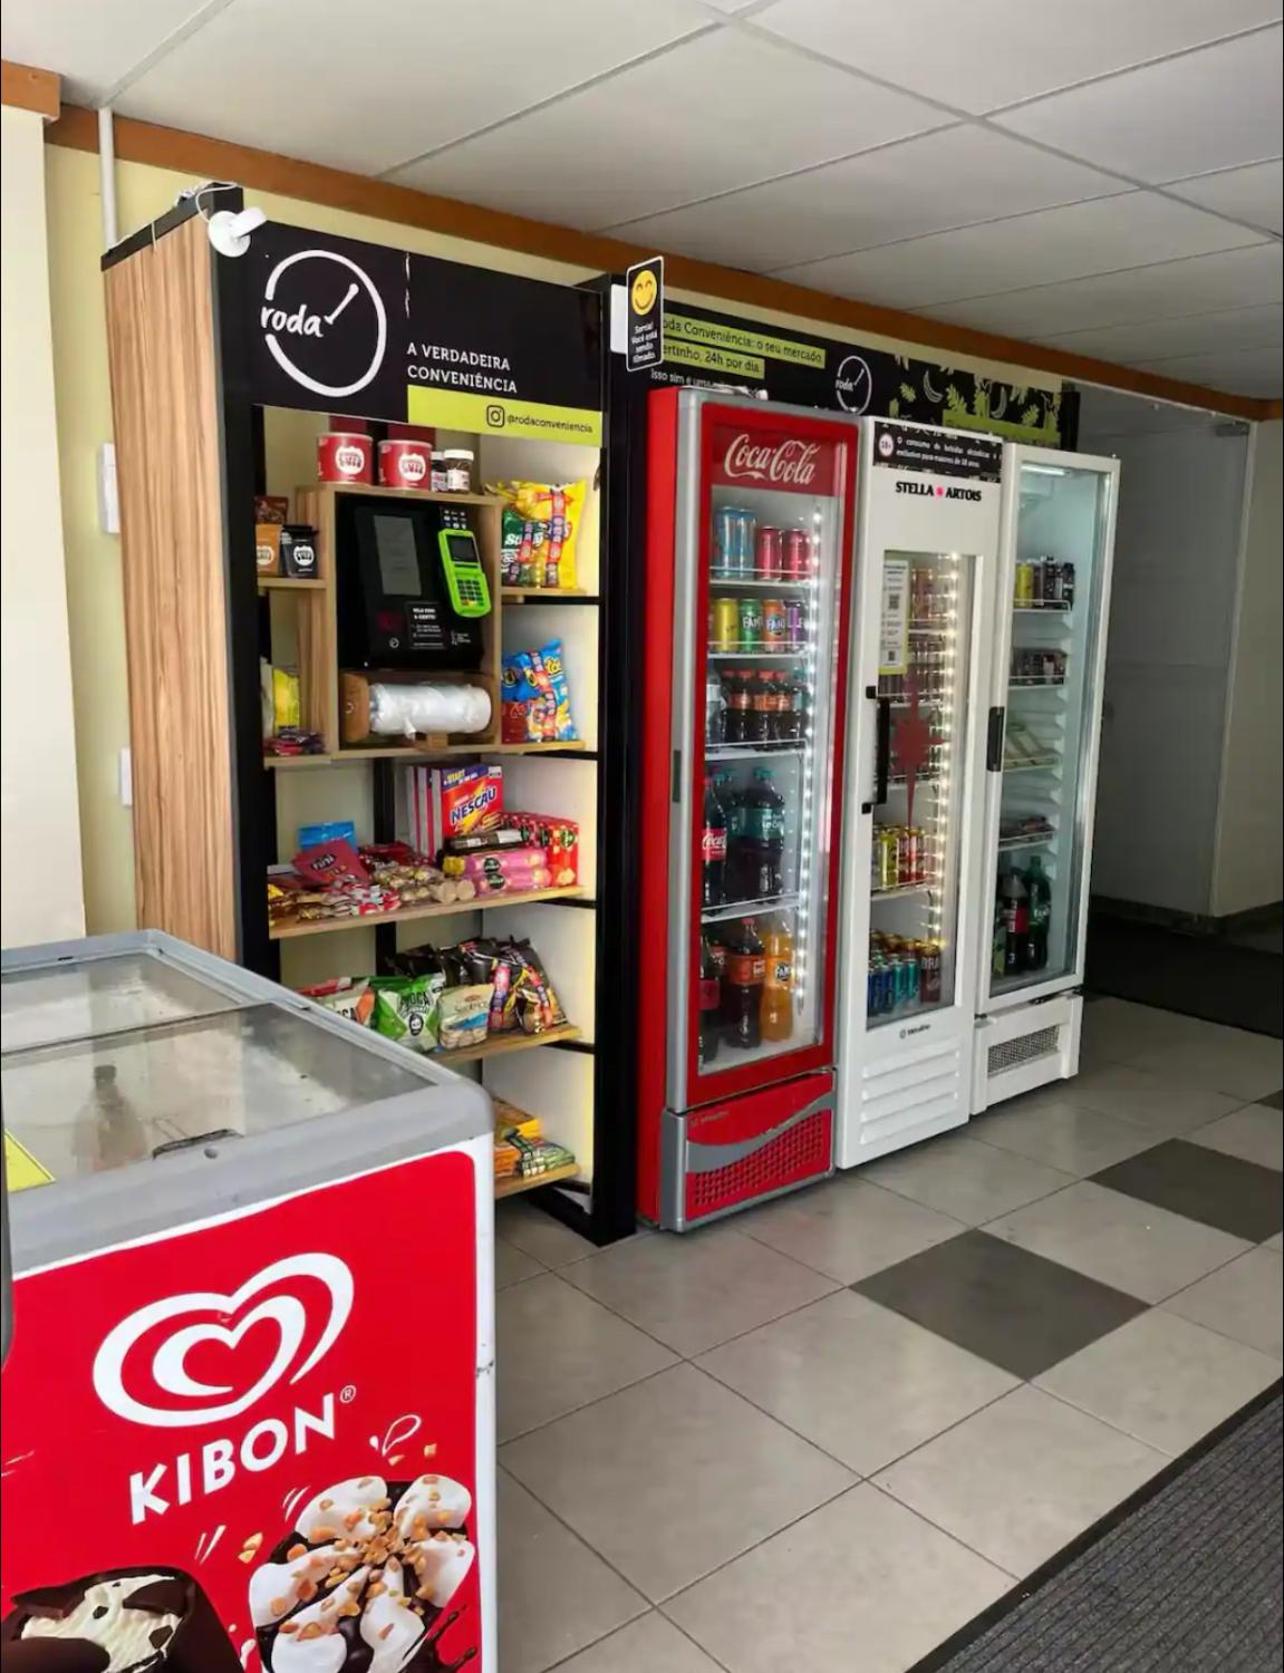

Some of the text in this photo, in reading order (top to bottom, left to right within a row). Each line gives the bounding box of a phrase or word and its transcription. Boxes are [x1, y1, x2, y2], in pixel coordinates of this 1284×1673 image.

[260, 304, 324, 338] roda
[406, 342, 511, 371] A VERDADEIRA
[704, 349, 723, 366] 24h
[726, 357, 742, 370] por
[407, 364, 518, 393] CONVENIÊNCIA
[724, 434, 821, 485] Coca-Cola
[895, 481, 982, 502] STELLA ARTOIS
[450, 787, 497, 827] NESCAU
[130, 1393, 335, 1525] KIBON
